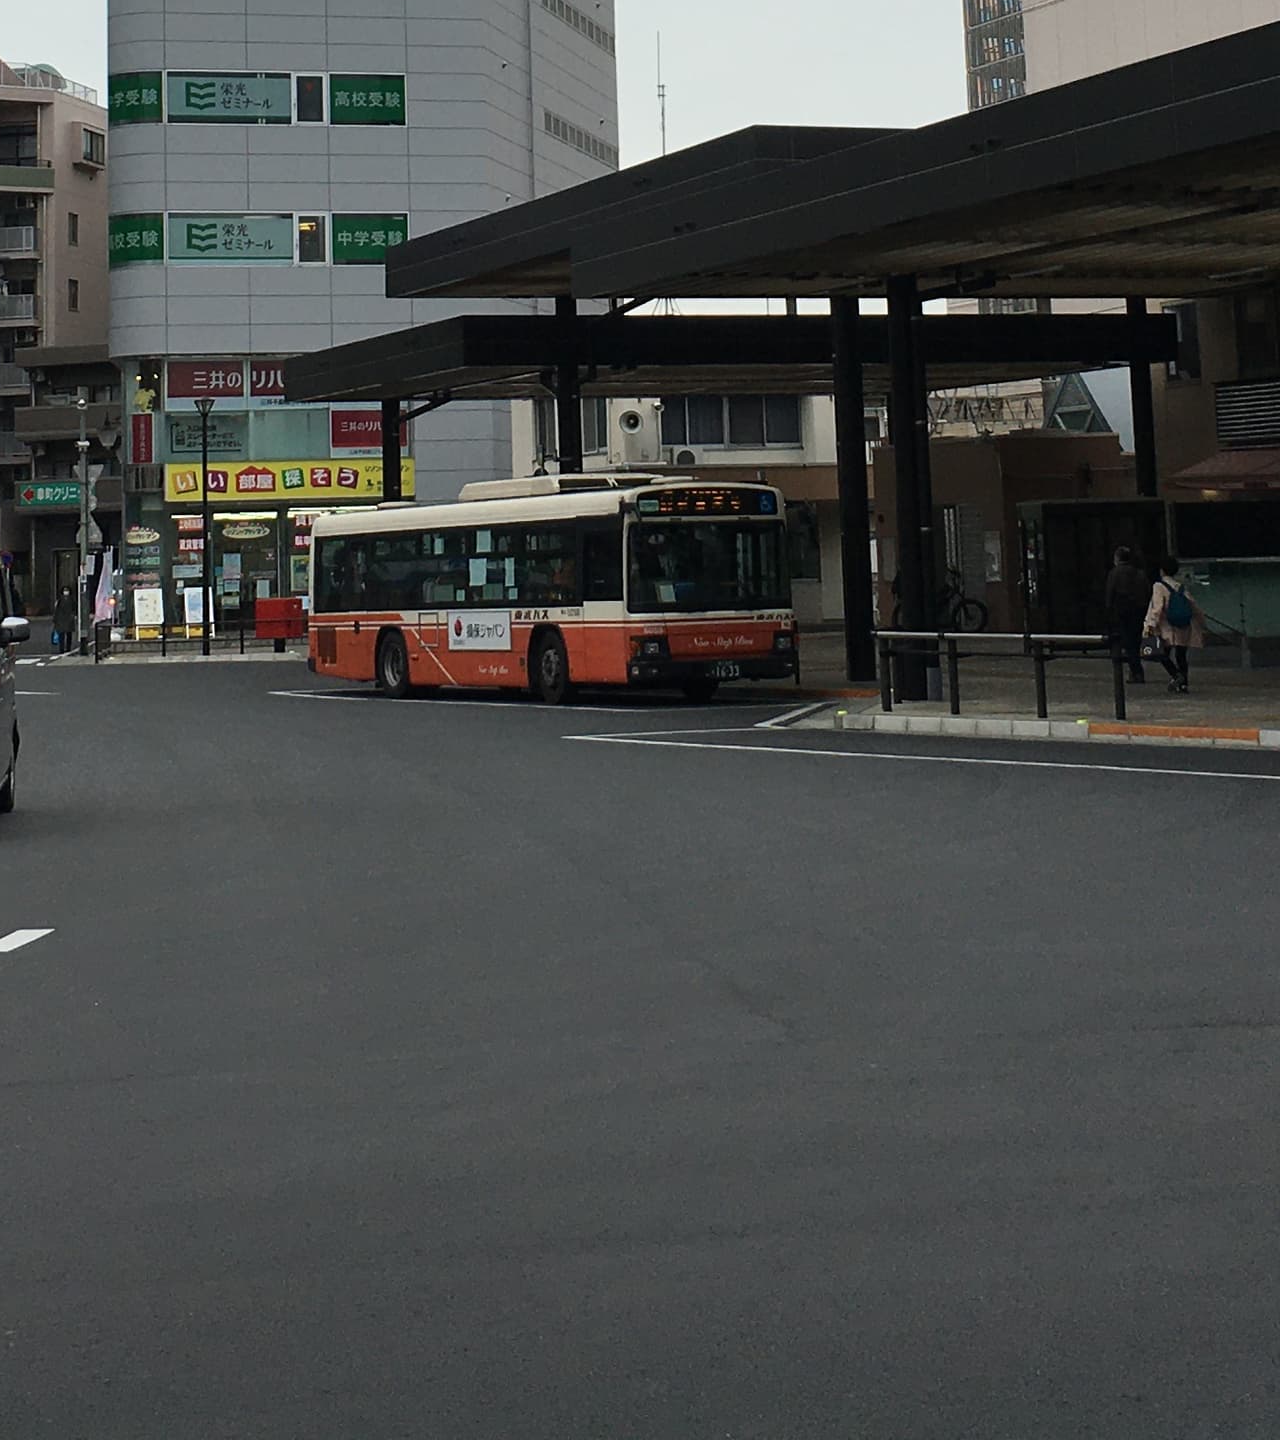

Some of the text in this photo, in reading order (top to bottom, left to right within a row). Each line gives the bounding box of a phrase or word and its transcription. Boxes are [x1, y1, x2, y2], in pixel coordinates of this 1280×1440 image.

[220, 82, 248, 97] 栄光
[220, 96, 273, 111] ゼミナール
[334, 90, 401, 109] 高校受験
[221, 222, 250, 238] 栄光
[221, 237, 274, 252] ゼミナール
